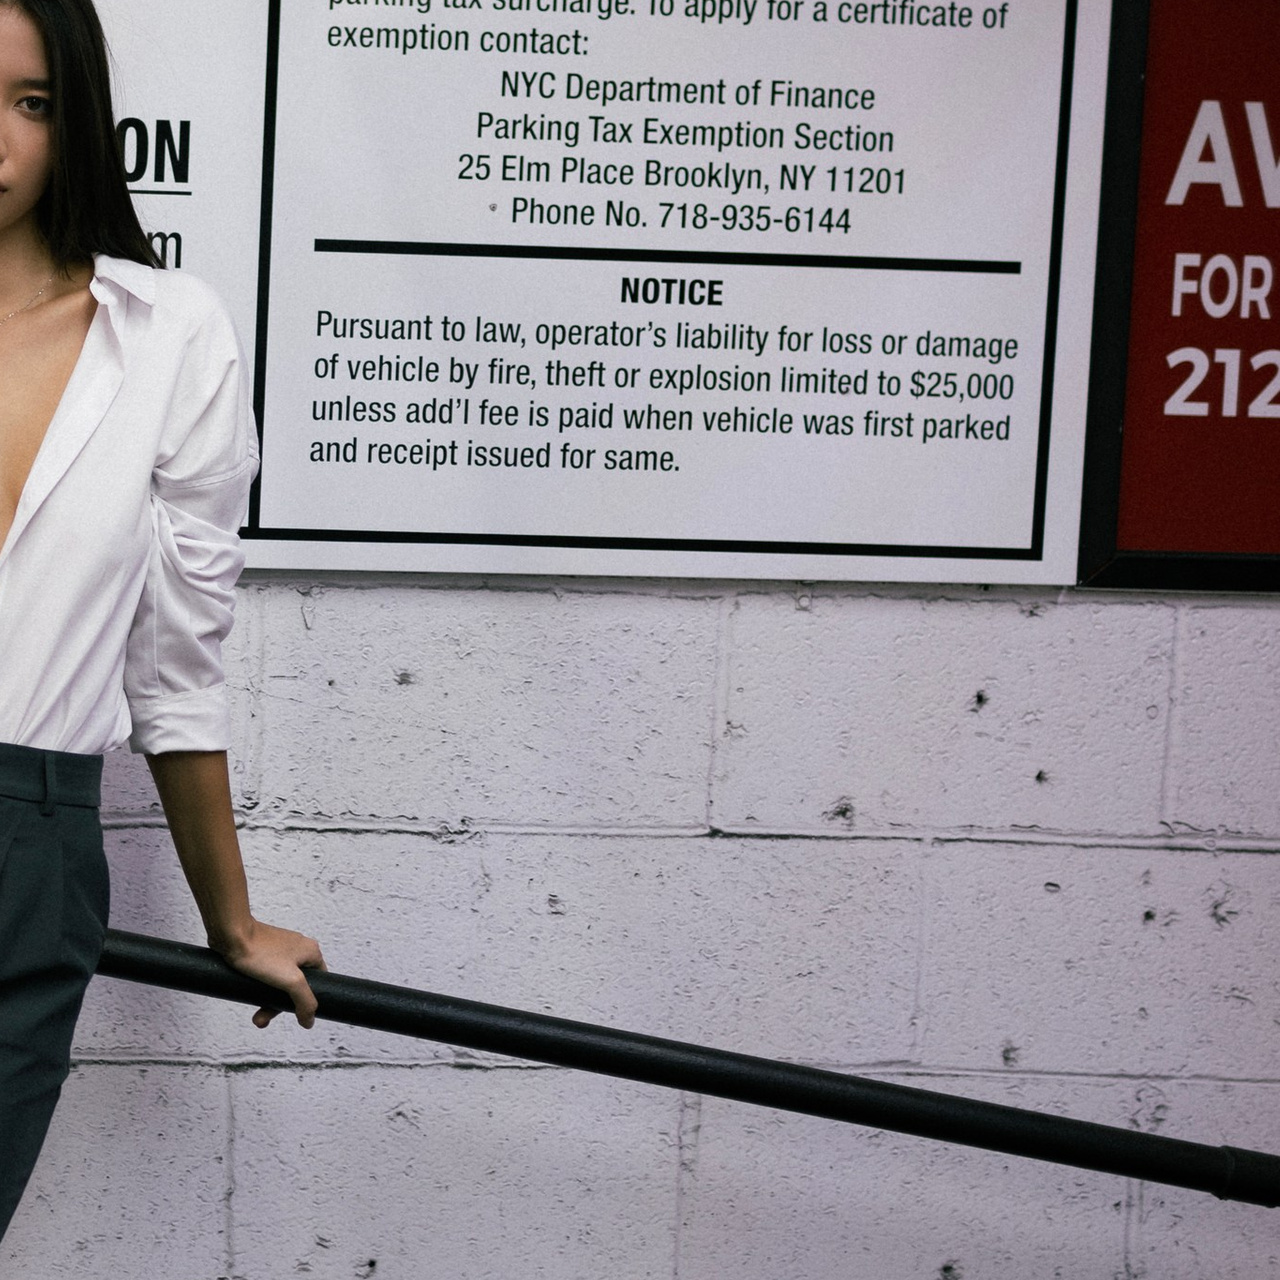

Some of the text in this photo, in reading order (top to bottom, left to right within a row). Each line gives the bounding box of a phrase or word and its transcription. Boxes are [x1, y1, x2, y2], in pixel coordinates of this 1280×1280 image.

[501, 70, 875, 110] NYC Department of Finance
[477, 111, 894, 153] Parking Tax Exemption Section
[458, 153, 905, 195] 25 Elm Place Brooklyn, NY 11201
[512, 197, 851, 234] Phone No. 718-935-6144
[621, 277, 723, 306] NOTICE
[1171, 253, 1274, 319] FOR
[316, 310, 1019, 365] Pursuant to law, operator's liability for loss or damage
